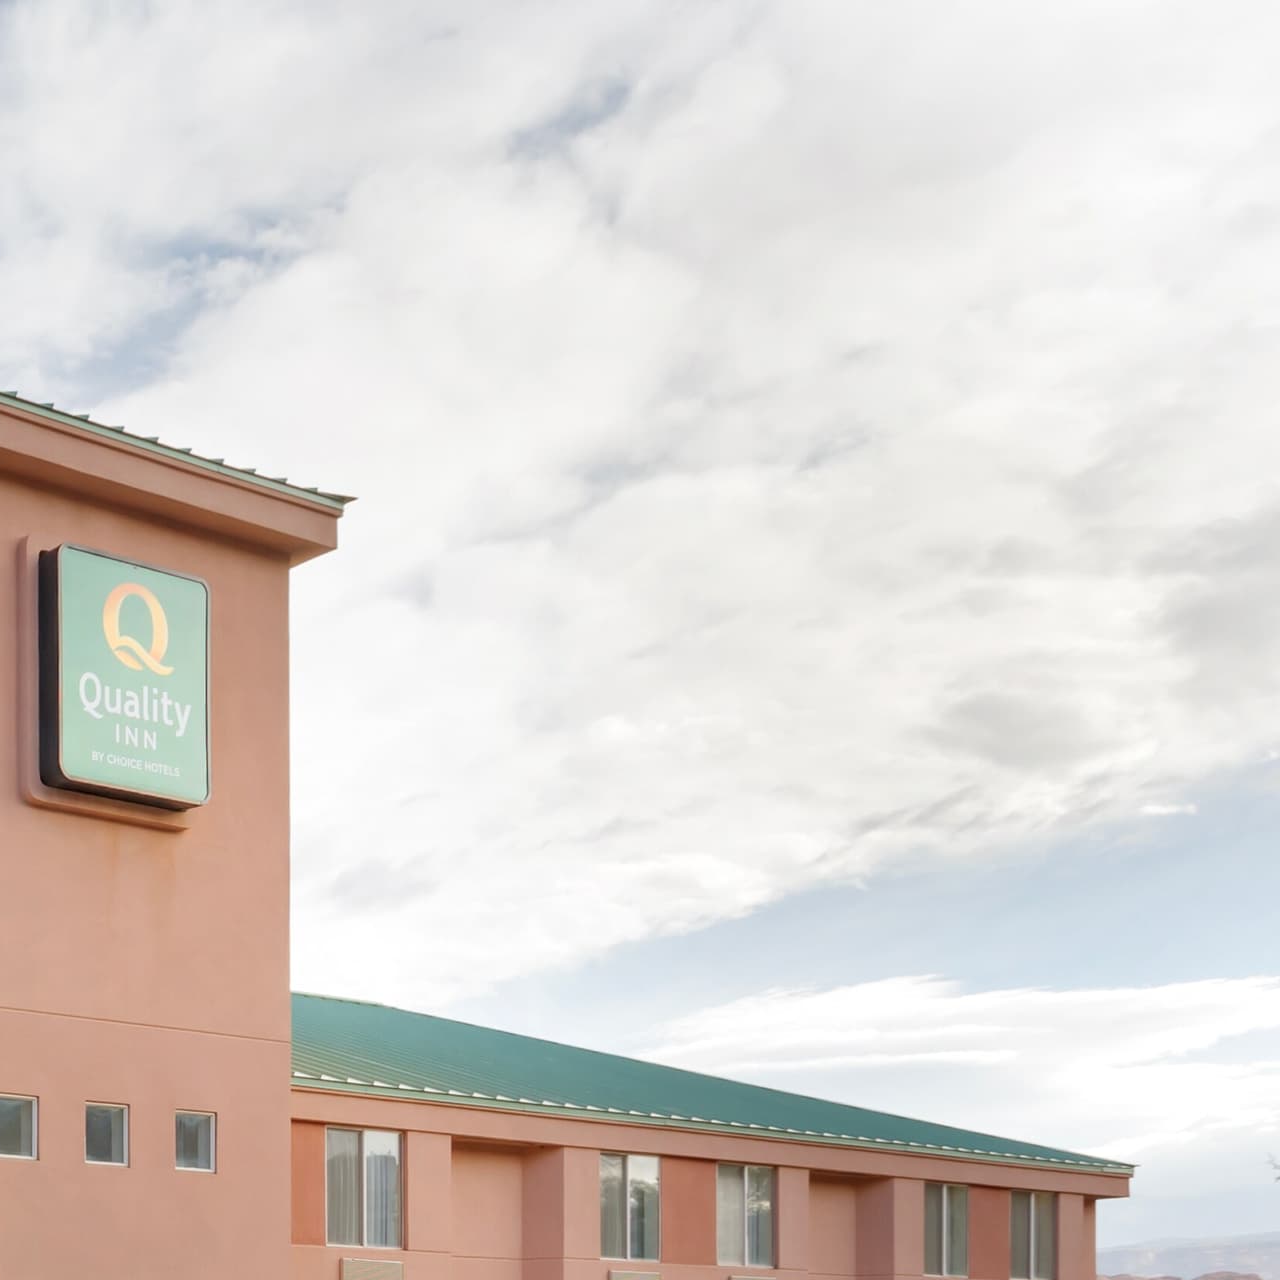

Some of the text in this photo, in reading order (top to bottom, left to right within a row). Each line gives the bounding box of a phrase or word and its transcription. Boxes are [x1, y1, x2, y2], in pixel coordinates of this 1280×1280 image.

[103, 582, 174, 676] Q
[79, 671, 192, 737] Quality
[115, 723, 157, 751] INN
[91, 751, 181, 777] BY CHOICE HOTELS
